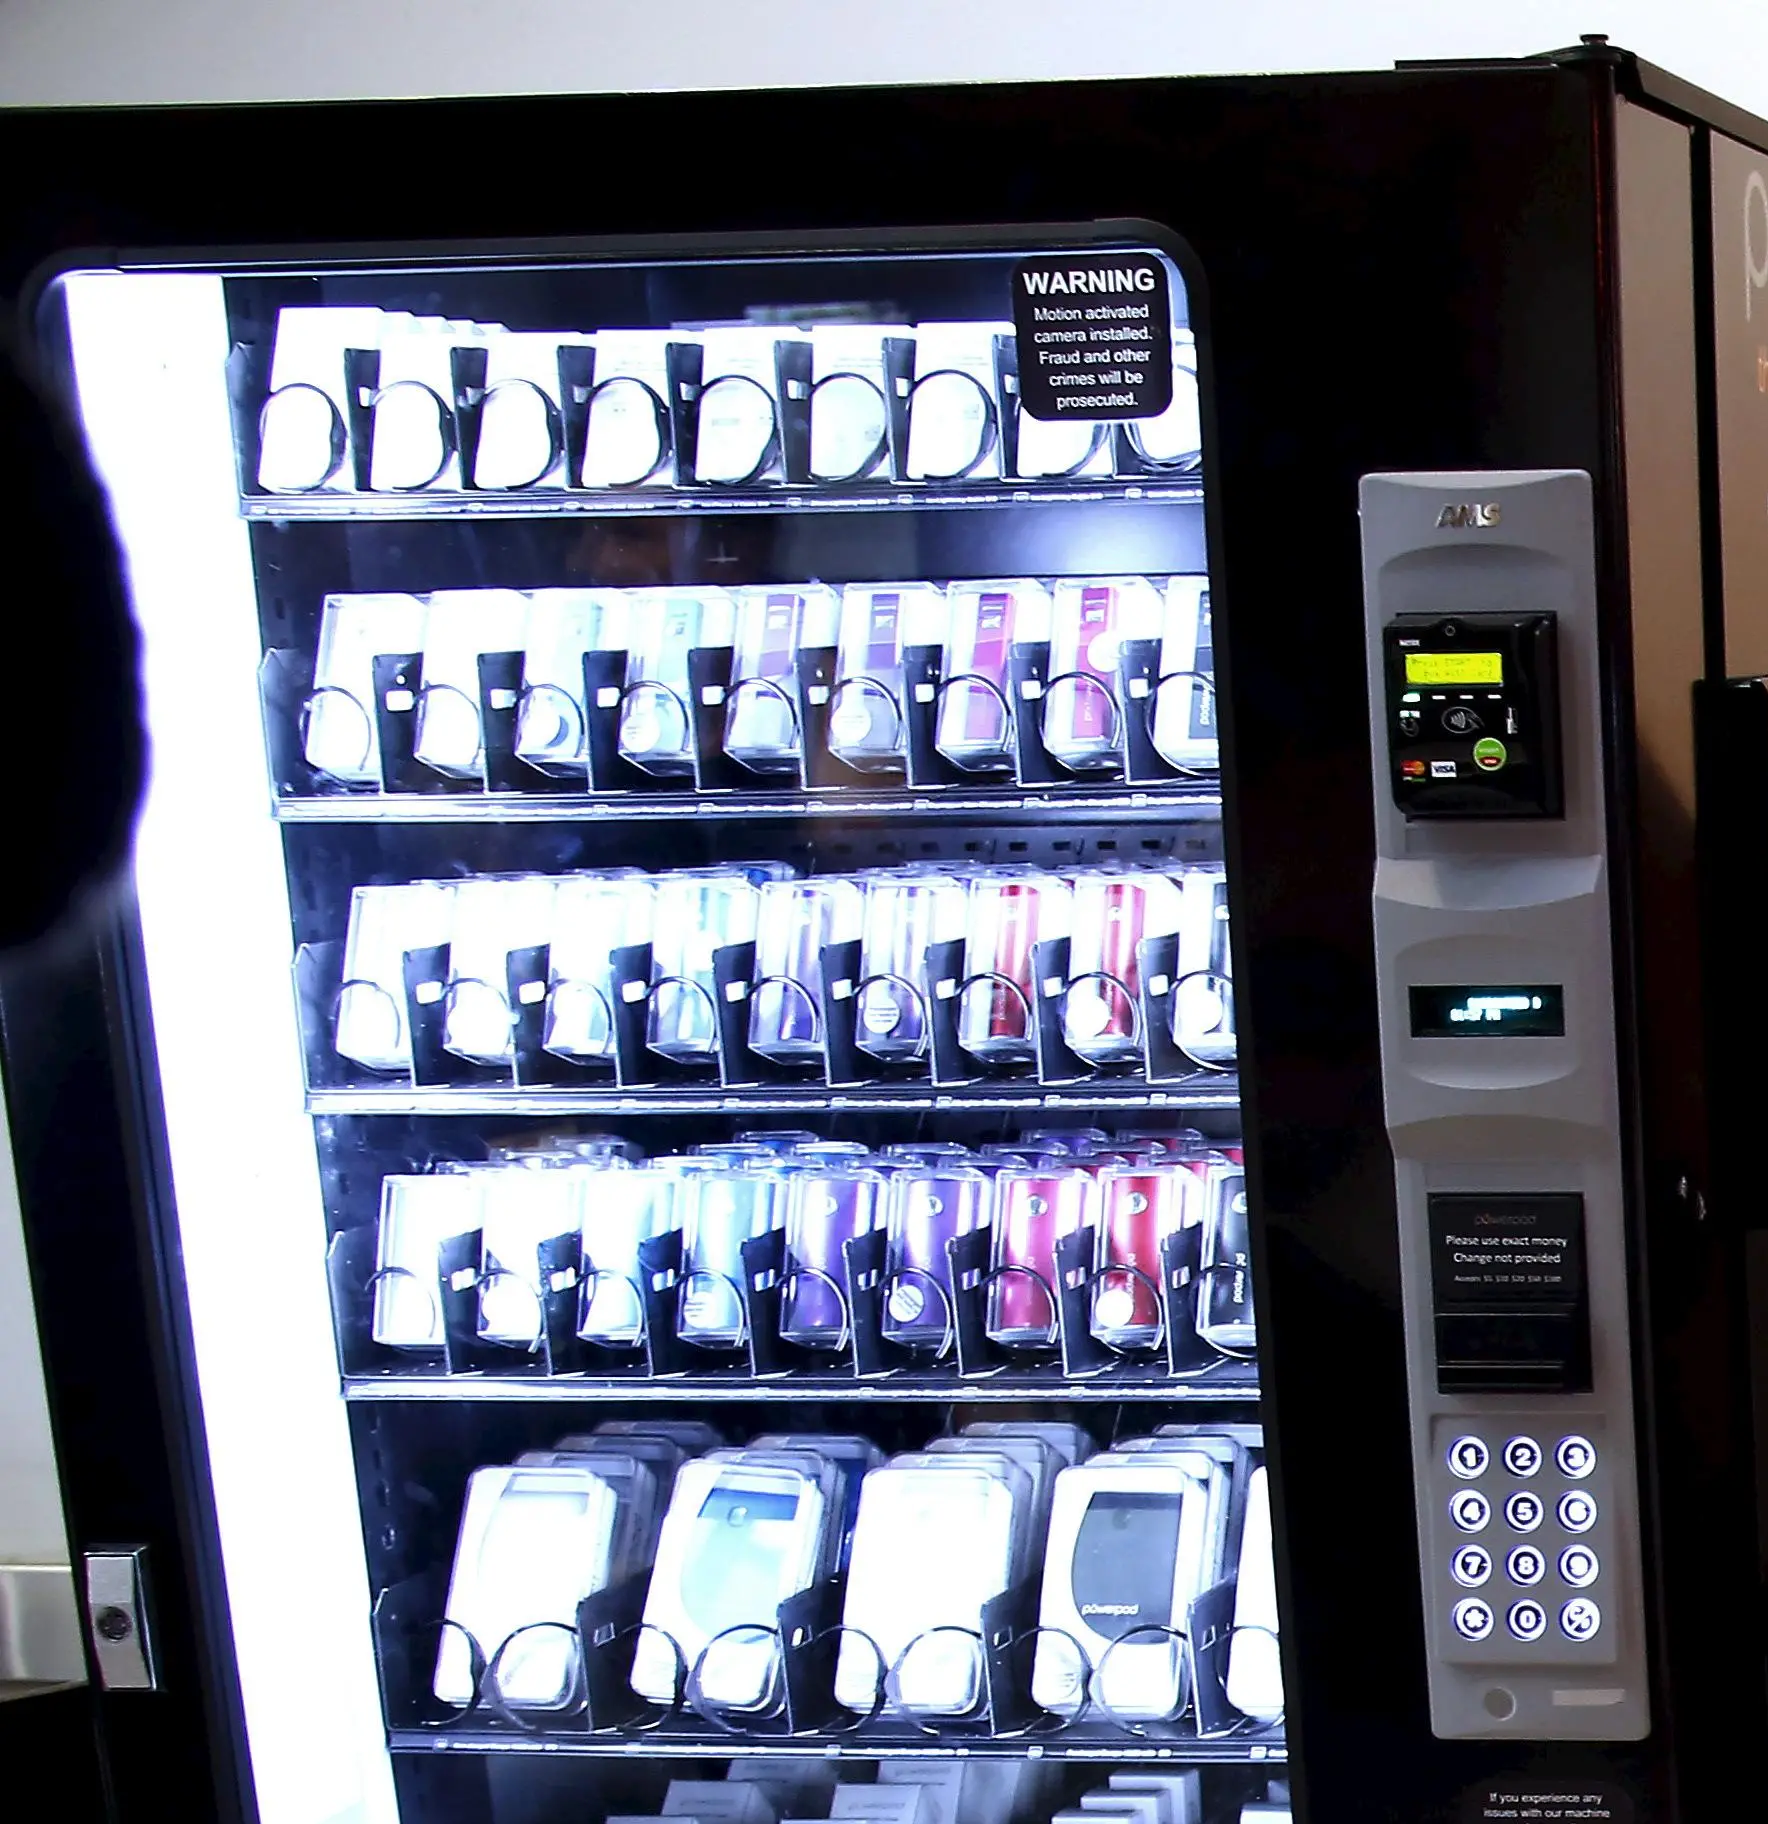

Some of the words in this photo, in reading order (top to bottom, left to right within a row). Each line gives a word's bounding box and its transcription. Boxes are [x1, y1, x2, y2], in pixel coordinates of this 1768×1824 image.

[1022, 268, 1155, 295] WARNING
[1034, 305, 1082, 322] Motion
[1085, 304, 1149, 321] activated
[1034, 330, 1087, 343] camera
[1090, 326, 1153, 342] installed.
[1039, 350, 1081, 365] Fraud
[1084, 350, 1110, 363] and
[1113, 349, 1151, 363] other
[1049, 372, 1096, 387] crimes
[1098, 371, 1121, 385] will
[1125, 371, 1144, 384] be
[1056, 392, 1139, 410] prosecuted.
[1434, 503, 1502, 528] AMS
[1446, 1235, 1479, 1246] Please
[1481, 1238, 1500, 1246] use
[1502, 1237, 1530, 1246] exact
[1532, 1238, 1568, 1249] money
[1454, 1252, 1492, 1264] Change
[1494, 1254, 1513, 1263] not
[1515, 1253, 1561, 1264] provided
[1515, 1448, 1531, 1467] 2
[1567, 1448, 1585, 1467] 3
[1462, 1501, 1481, 1522] 4
[1516, 1502, 1533, 1521] 5
[1518, 1556, 1534, 1576] 8
[1520, 1610, 1536, 1630] 0
[1489, 1792, 1497, 1803] If
[1499, 1795, 1519, 1805] you
[1521, 1793, 1580, 1804] experience
[1582, 1795, 1603, 1805] any
[1483, 1808, 1518, 1818] issues
[1520, 1808, 1542, 1818] with
[1544, 1810, 1562, 1818] our
[1565, 1808, 1611, 1818] machine
